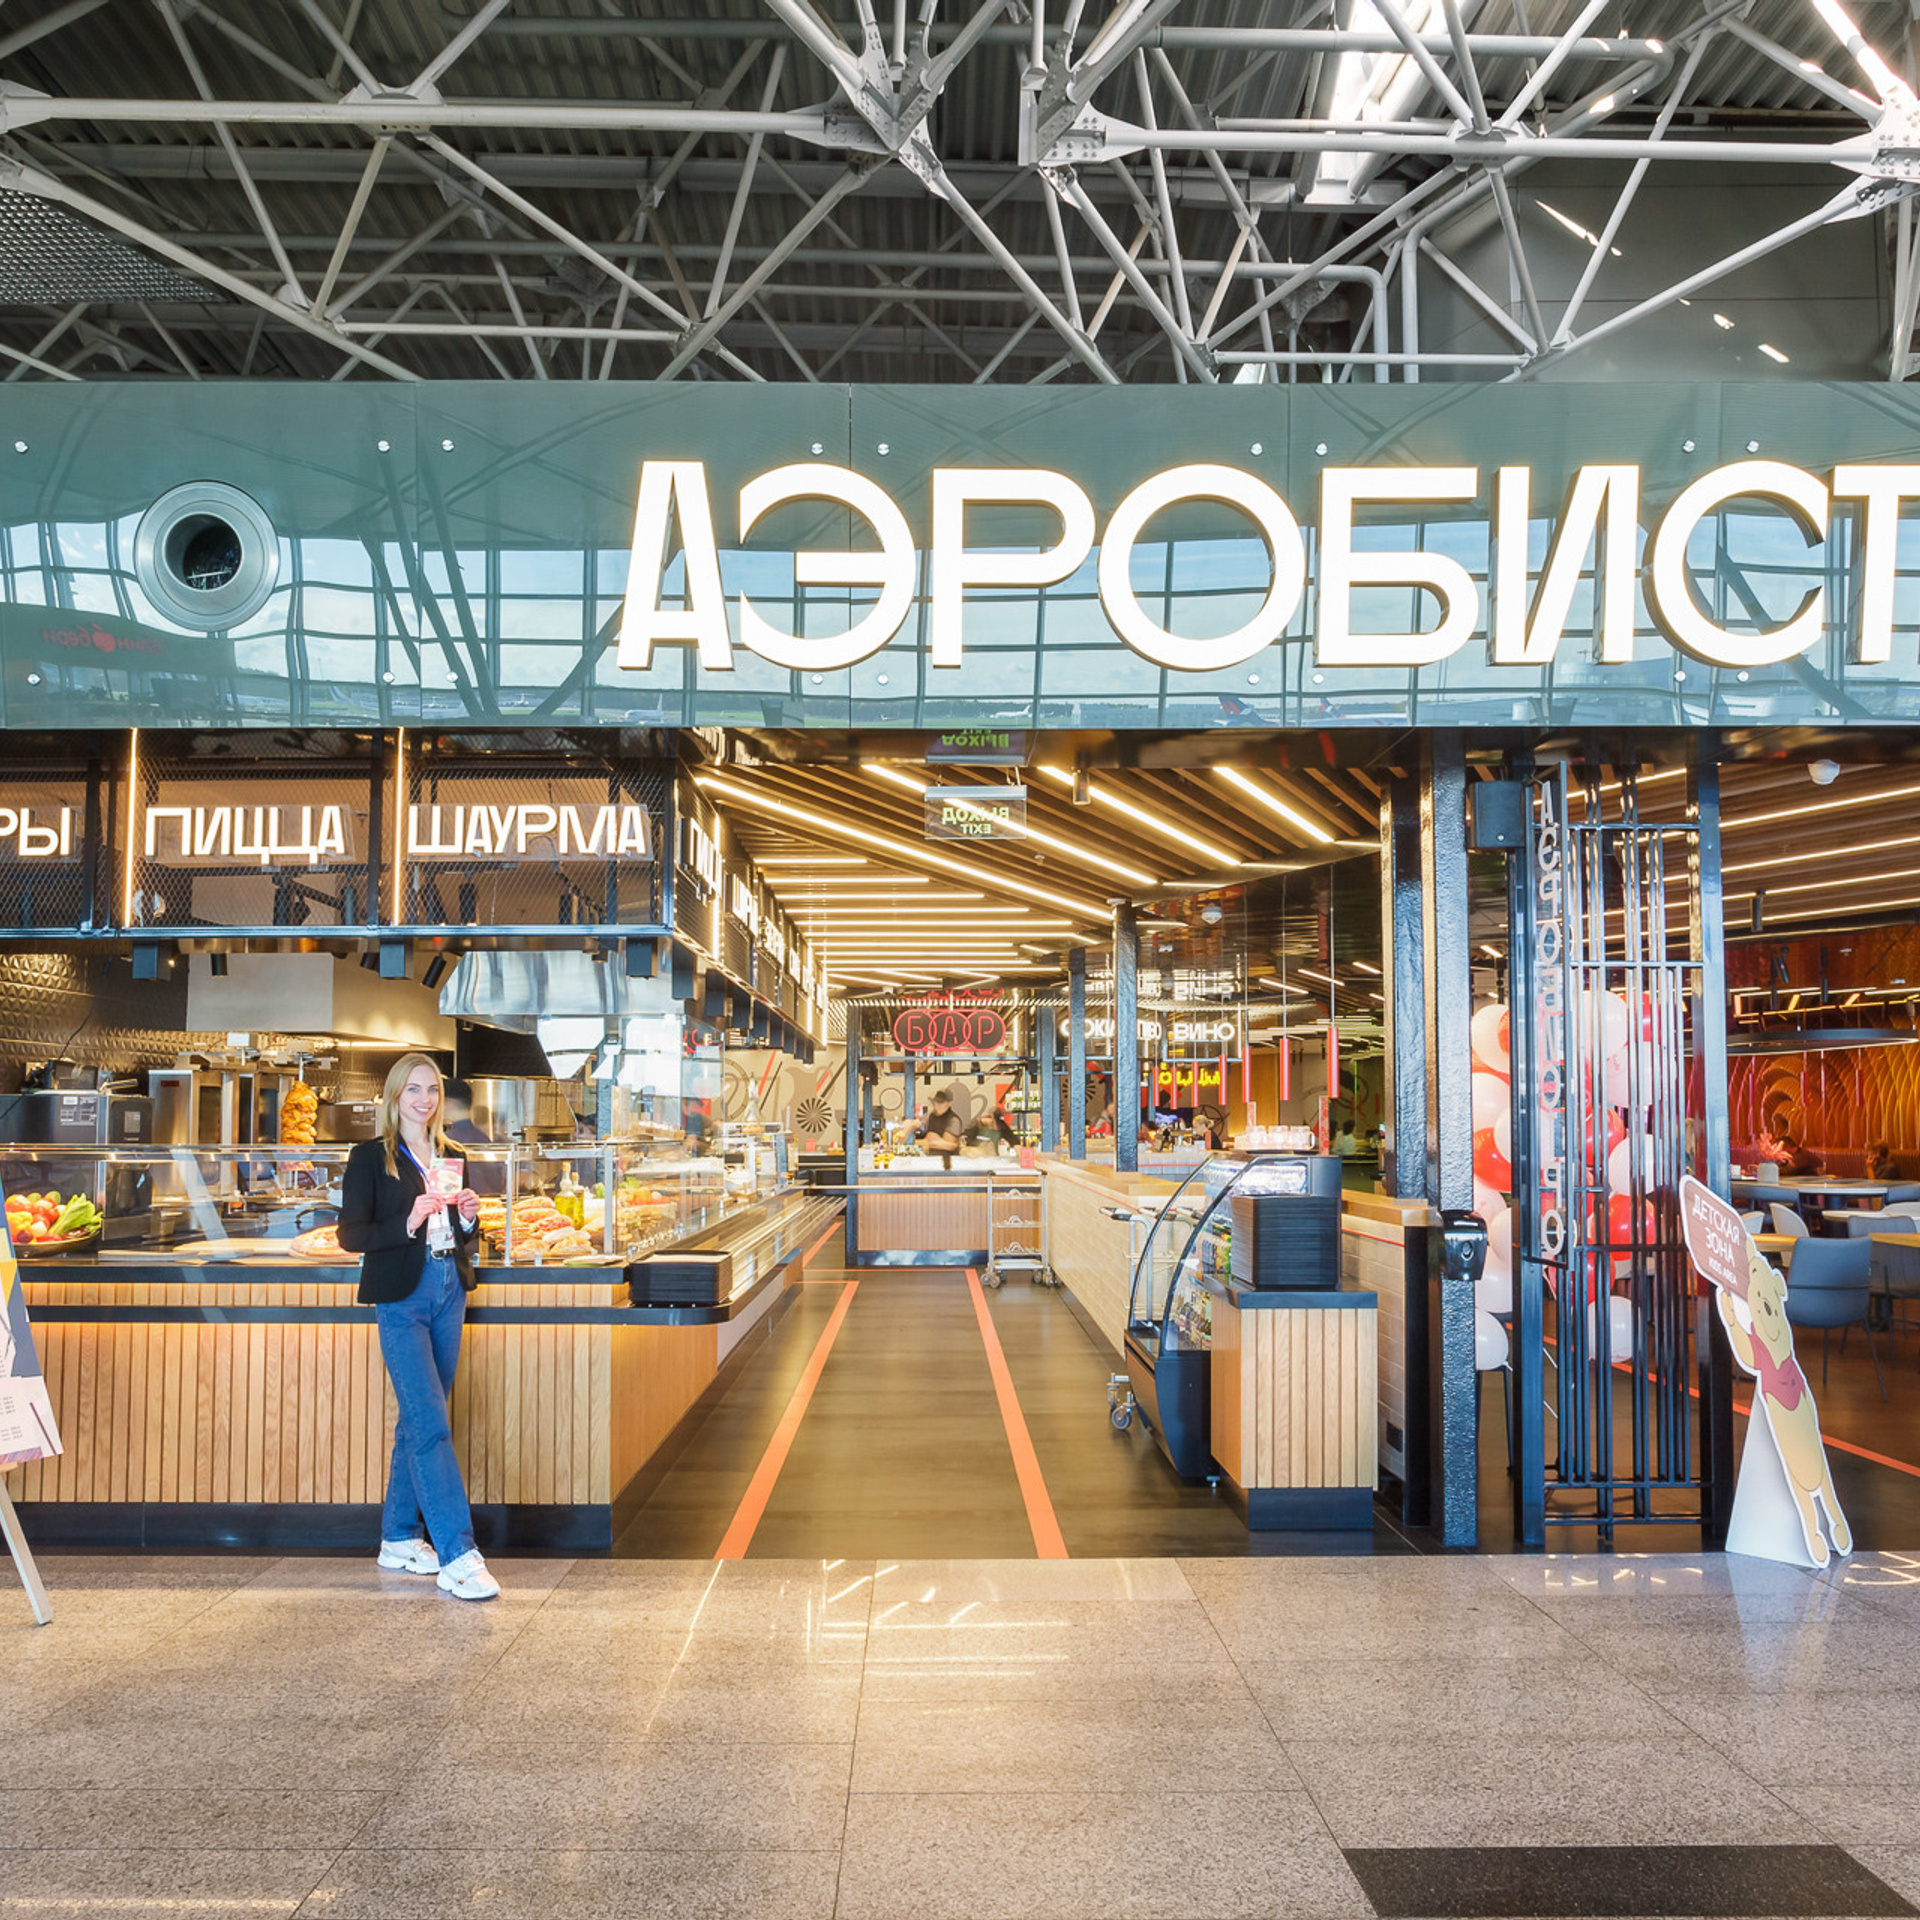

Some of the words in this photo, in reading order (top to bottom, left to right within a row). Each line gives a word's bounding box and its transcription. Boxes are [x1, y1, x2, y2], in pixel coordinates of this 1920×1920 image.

[616, 460, 1920, 671] АЭРОБИСТ
[144, 805, 347, 865] ПИЦЦА
[406, 804, 648, 855] ШАУРМА
[906, 1014, 996, 1046] БАР
[1173, 1021, 1236, 1042] ВИНО
[1691, 1192, 1741, 1247] ДЕТСКАЯ
[1704, 1226, 1736, 1269] ЗОНА
